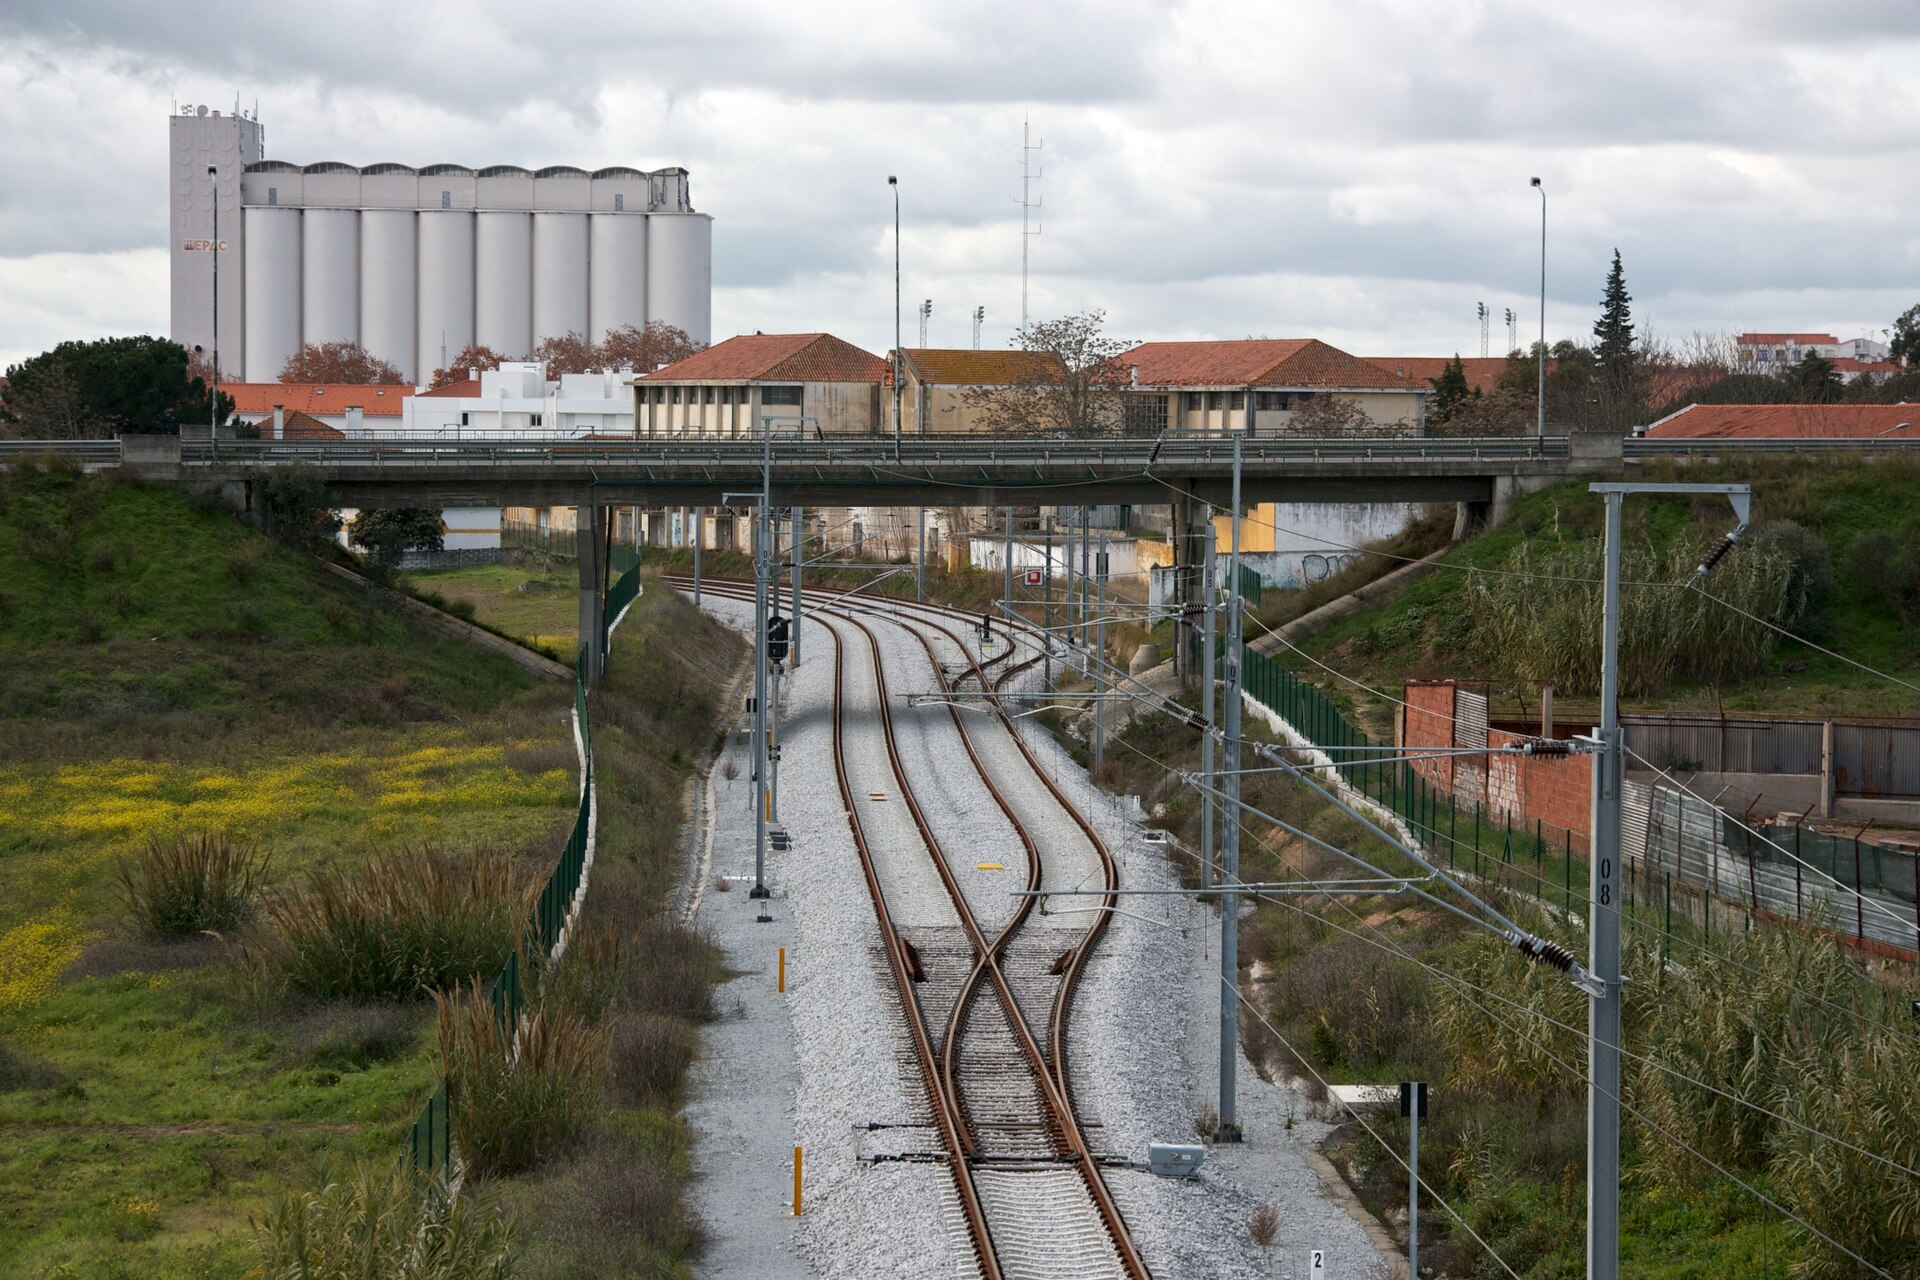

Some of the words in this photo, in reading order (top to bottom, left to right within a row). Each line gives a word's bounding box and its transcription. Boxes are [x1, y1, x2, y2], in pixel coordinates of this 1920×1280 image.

[194, 240, 227, 251] EPAC
[762, 550, 768, 568] 06
[1207, 569, 1213, 588] 05
[1229, 665, 1236, 693] 07
[1600, 857, 1611, 906] 08
[1314, 1252, 1322, 1268] 2
